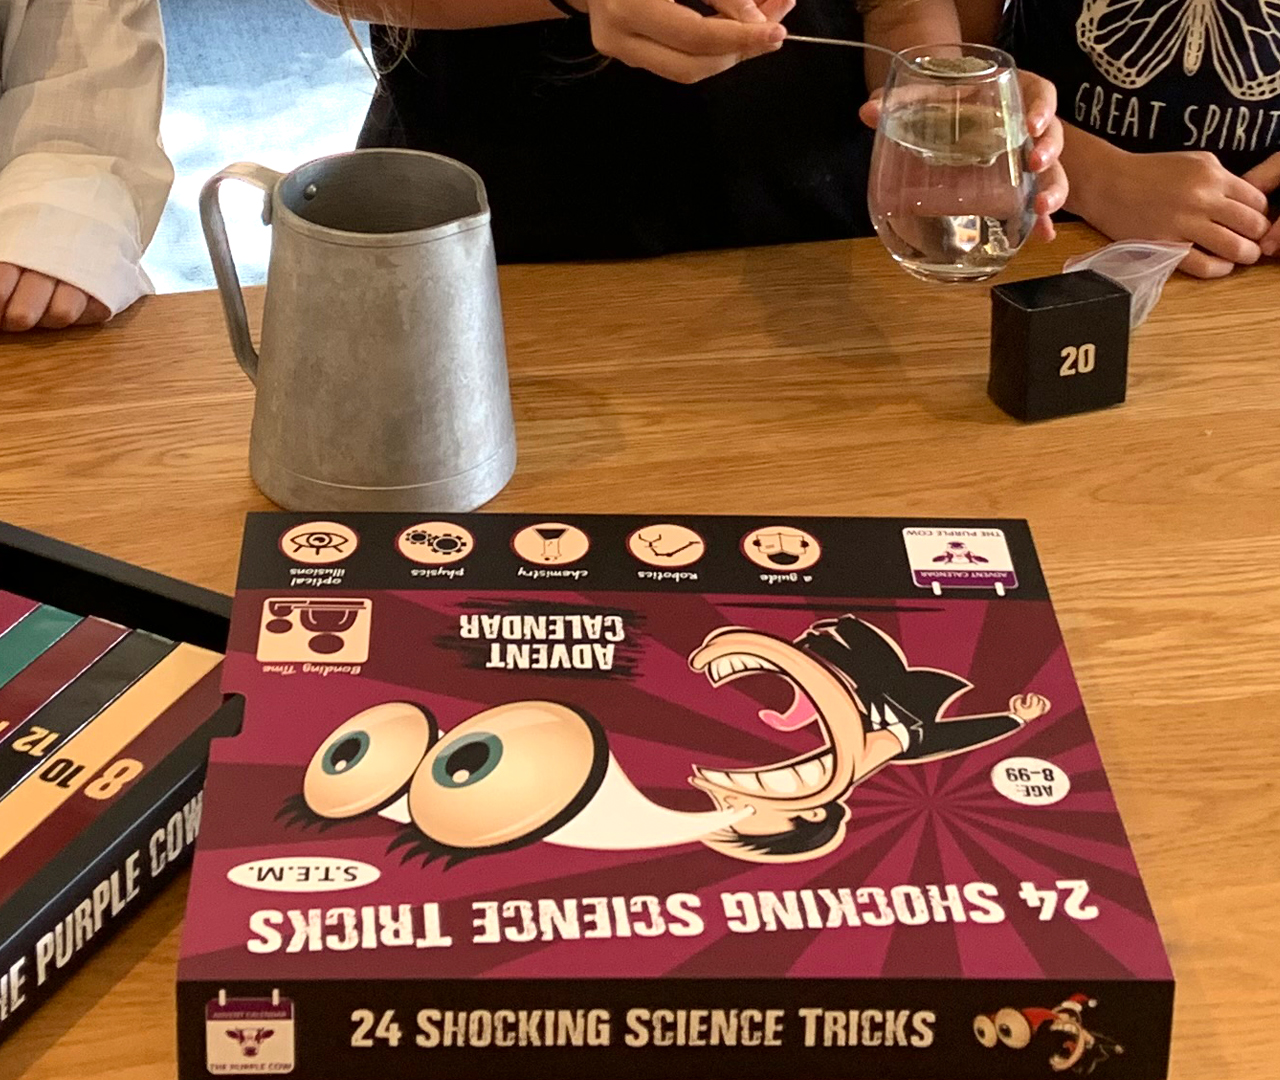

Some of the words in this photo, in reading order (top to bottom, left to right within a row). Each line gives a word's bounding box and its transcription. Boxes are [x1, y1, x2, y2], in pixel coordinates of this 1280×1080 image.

[1075, 82, 1166, 140] GREAT
[1059, 343, 1096, 377] 20
[906, 529, 933, 537] COW
[980, 530, 1002, 538] THE
[289, 567, 347, 577] illusions
[290, 576, 343, 587] optical
[410, 566, 465, 580] physics
[516, 567, 589, 580] chemistry
[760, 572, 799, 584] guide
[459, 613, 626, 643] CALENDAR
[262, 662, 296, 675] Time
[302, 662, 362, 676] Bonding
[486, 642, 616, 670] ADVENT
[12, 726, 62, 755] 12
[40, 758, 85, 787] 10
[86, 758, 144, 800] 8
[1005, 767, 1055, 783] 8-99
[1015, 783, 1055, 800] AGE:
[35, 852, 140, 987] PURPLE
[149, 789, 203, 878] COW
[247, 864, 359, 884] S.T.E.M.
[721, 881, 1006, 934] SHOCKING
[1019, 879, 1100, 923] 24
[246, 901, 453, 956] TRICKS
[472, 891, 705, 946] SCIENCE
[350, 1009, 402, 1048] 24
[416, 1008, 610, 1049] SHOCKING
[625, 1007, 784, 1049] SCIENCE
[799, 1007, 937, 1049] TRICKS
